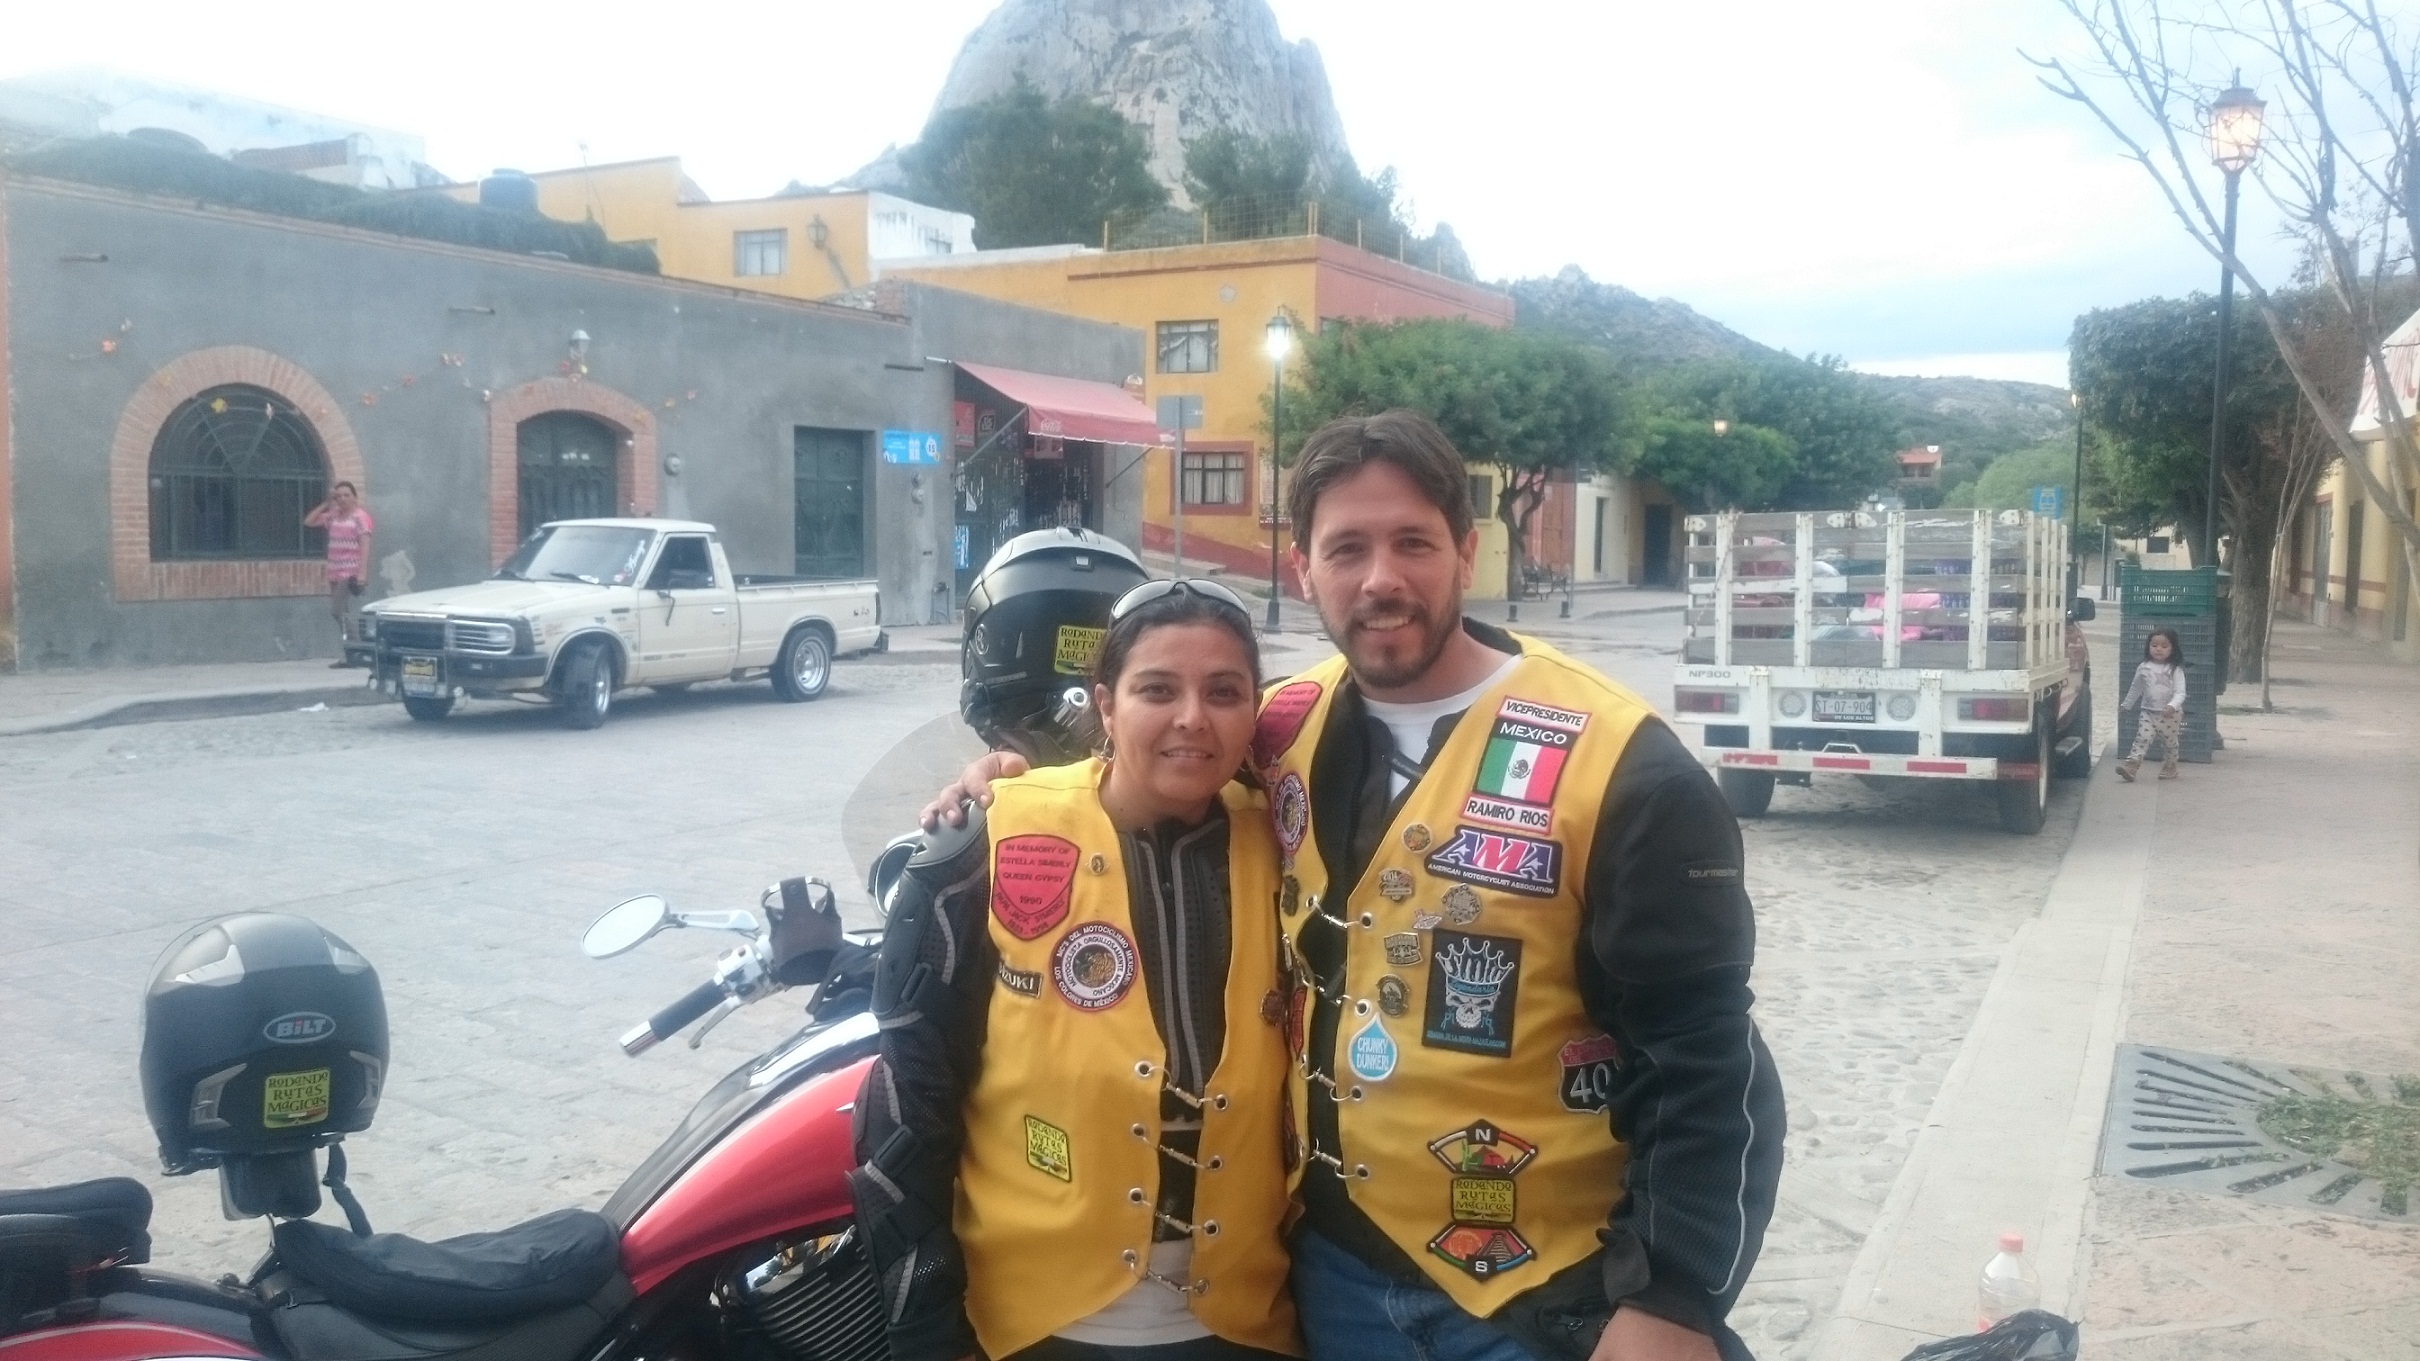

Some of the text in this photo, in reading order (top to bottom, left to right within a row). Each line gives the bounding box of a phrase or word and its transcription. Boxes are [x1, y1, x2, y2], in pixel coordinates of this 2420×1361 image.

[1689, 670, 1731, 678] NP300
[1506, 701, 1583, 726] VICEPRESIDENTE
[1500, 722, 1567, 745] MEXICO
[1467, 800, 1548, 827] RAMIRO RIOS
[1017, 845, 1057, 853] MEMORY
[1432, 829, 1553, 883] AMA
[1000, 857, 1035, 866] ESTELLA
[1003, 872, 1065, 882] QUEEN GYPSY
[1428, 863, 1555, 894] AMERICAN MOTORCYCLIST ASSOCIATION
[1069, 930, 1081, 941] DEL
[1083, 925, 1128, 949] MOTOCICLISMO
[1122, 949, 1134, 985] MEXICANO
[1054, 966, 1062, 980] LOS
[1058, 981, 1082, 1005] COLORES
[1092, 974, 1121, 996] MEXICANO
[1357, 1037, 1388, 1054] CHUNKY
[1357, 1053, 1389, 1071] DUNKER!
[1475, 1128, 1491, 1142] N
[1475, 1260, 1488, 1273] S
